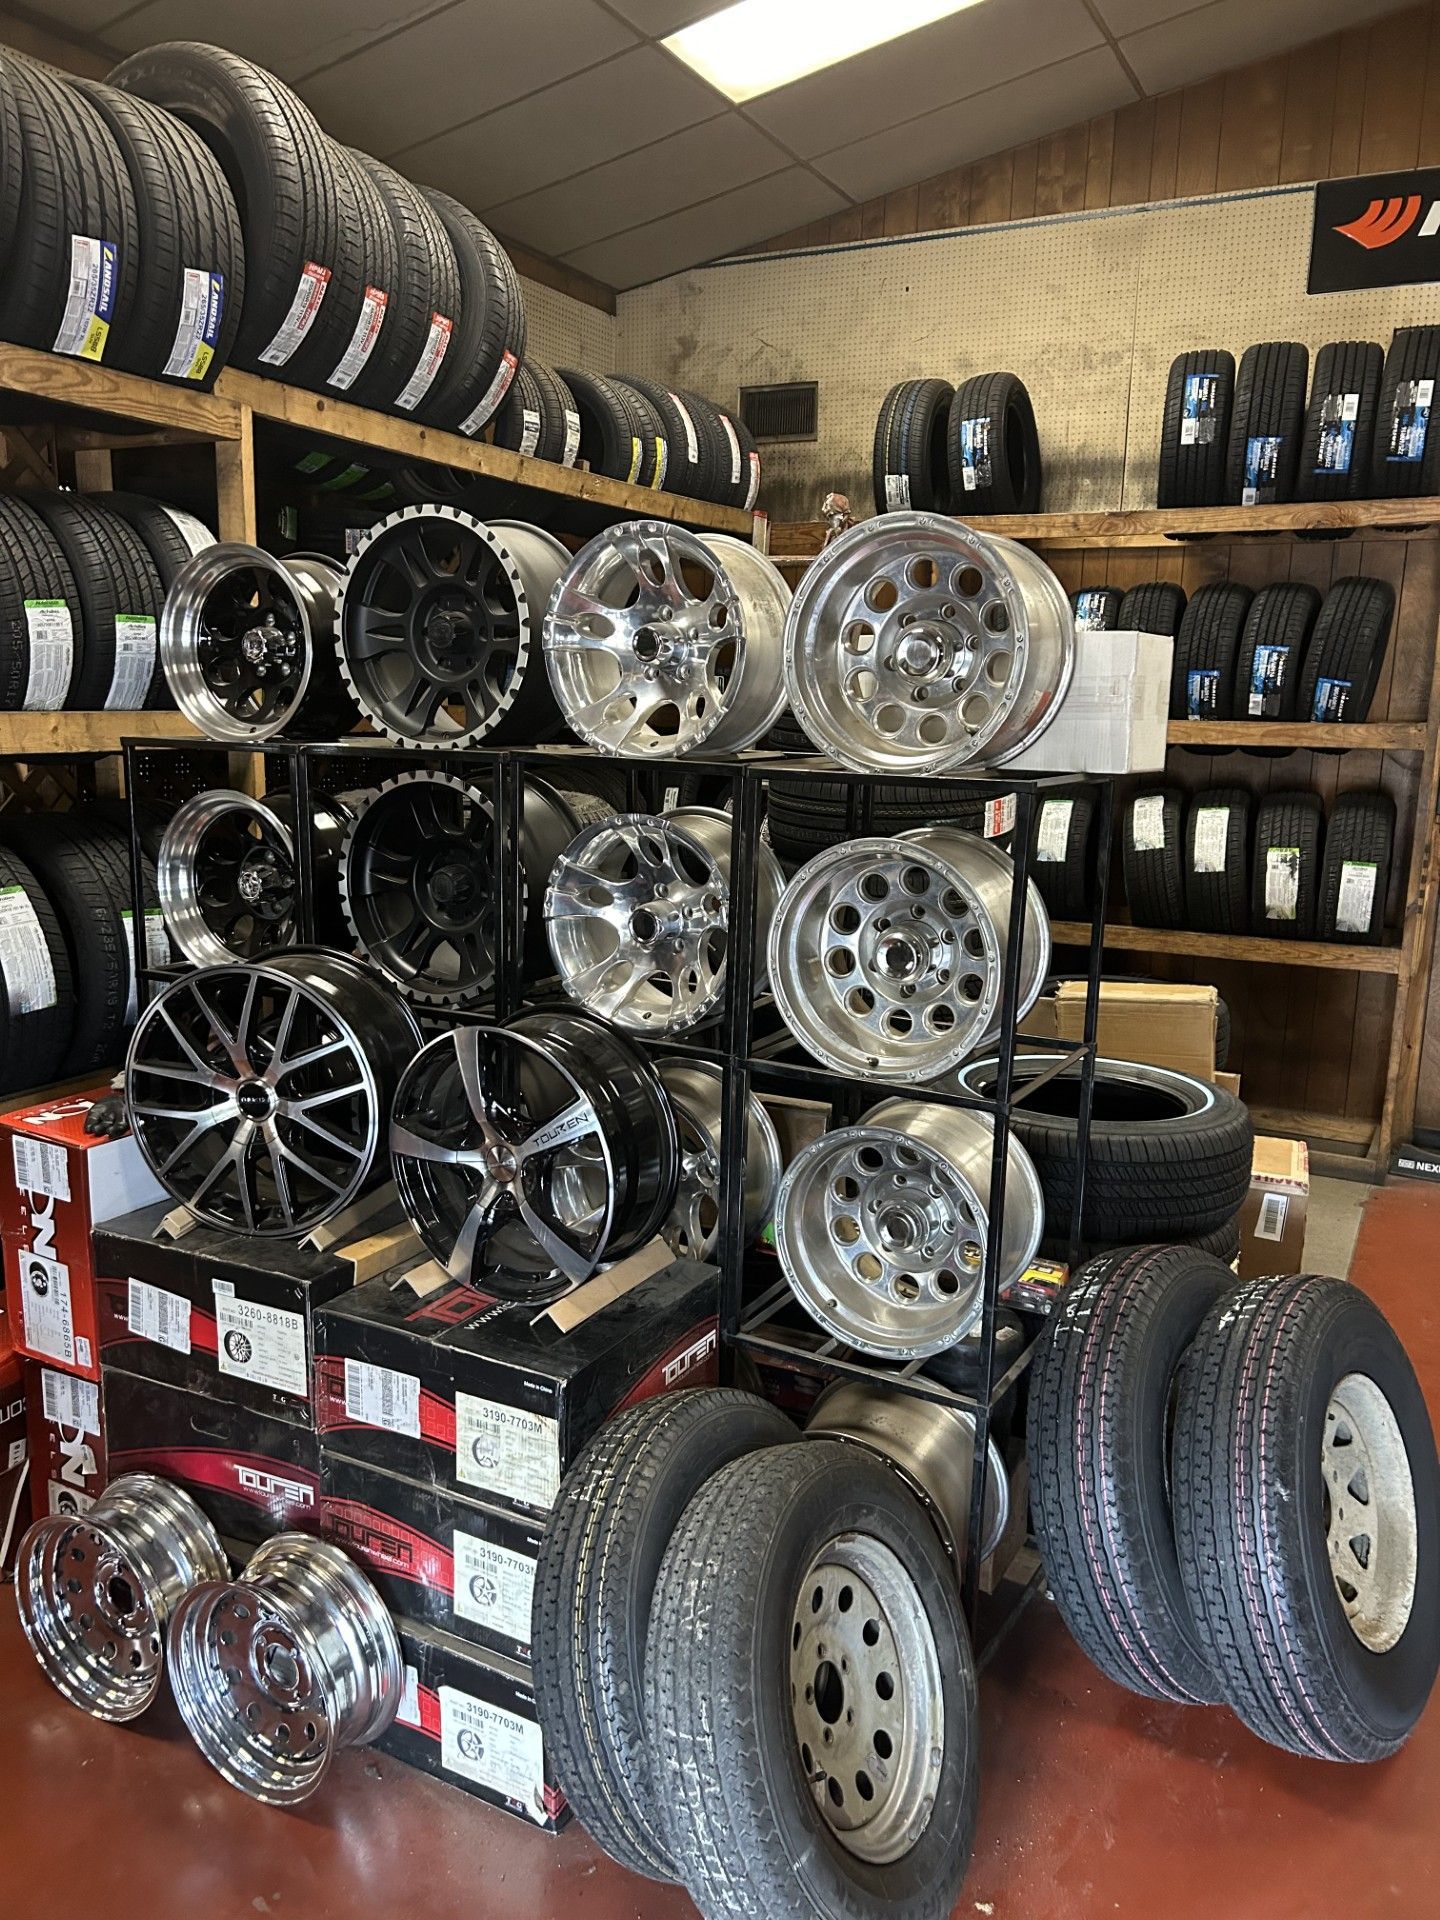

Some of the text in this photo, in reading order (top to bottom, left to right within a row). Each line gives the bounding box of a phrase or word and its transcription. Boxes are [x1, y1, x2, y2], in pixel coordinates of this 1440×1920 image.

[100, 247, 113, 312] LANDSAIL
[207, 280, 219, 338] LANDSAIL
[533, 1112, 589, 1147] TOUREN
[1416, 1161, 1440, 1174] NEX
[60, 1292, 72, 1358] 174-6865B
[238, 1303, 299, 1332] 3260-8818B
[483, 1406, 544, 1434] 3190-7703M
[233, 1464, 314, 1506] TOUREN
[466, 1702, 524, 1734] 3190-7703M
